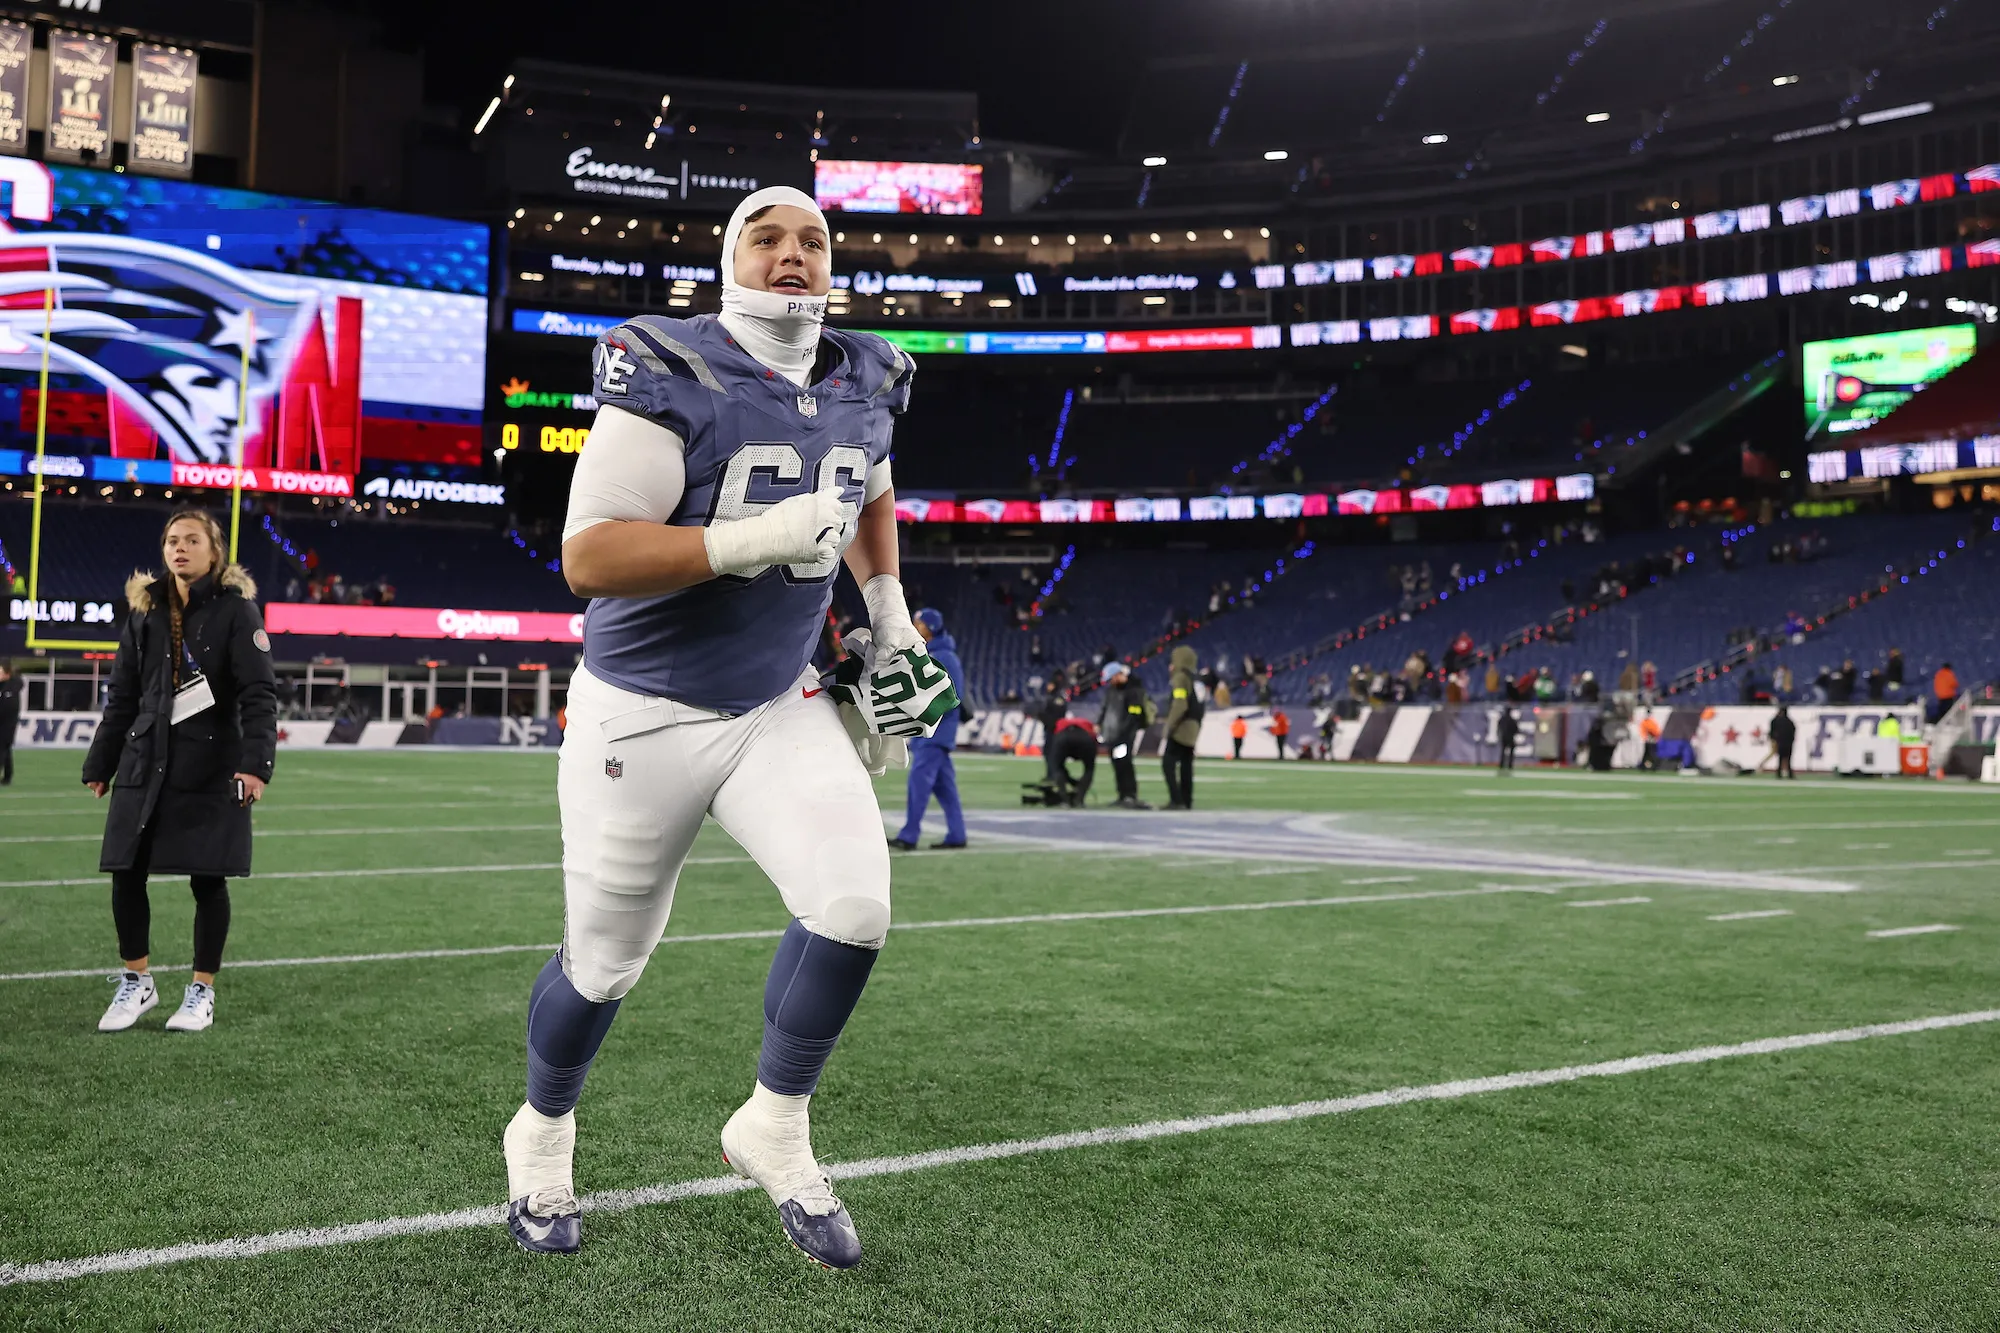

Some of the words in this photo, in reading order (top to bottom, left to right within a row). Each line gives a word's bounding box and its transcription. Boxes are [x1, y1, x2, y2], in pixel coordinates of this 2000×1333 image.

[566, 147, 679, 185] Encore
[574, 178, 622, 195] BOSTON
[690, 174, 758, 191] TERRACE
[502, 423, 519, 450] 0
[27, 460, 85, 477] GEICO
[175, 464, 258, 489] TOYOTA
[269, 471, 351, 494] TOYOTA
[390, 479, 505, 505] AUTODESK
[10, 599, 50, 621] BALL
[51, 600, 76, 621] ON
[82, 602, 114, 623] 24
[437, 609, 519, 638] Optum
